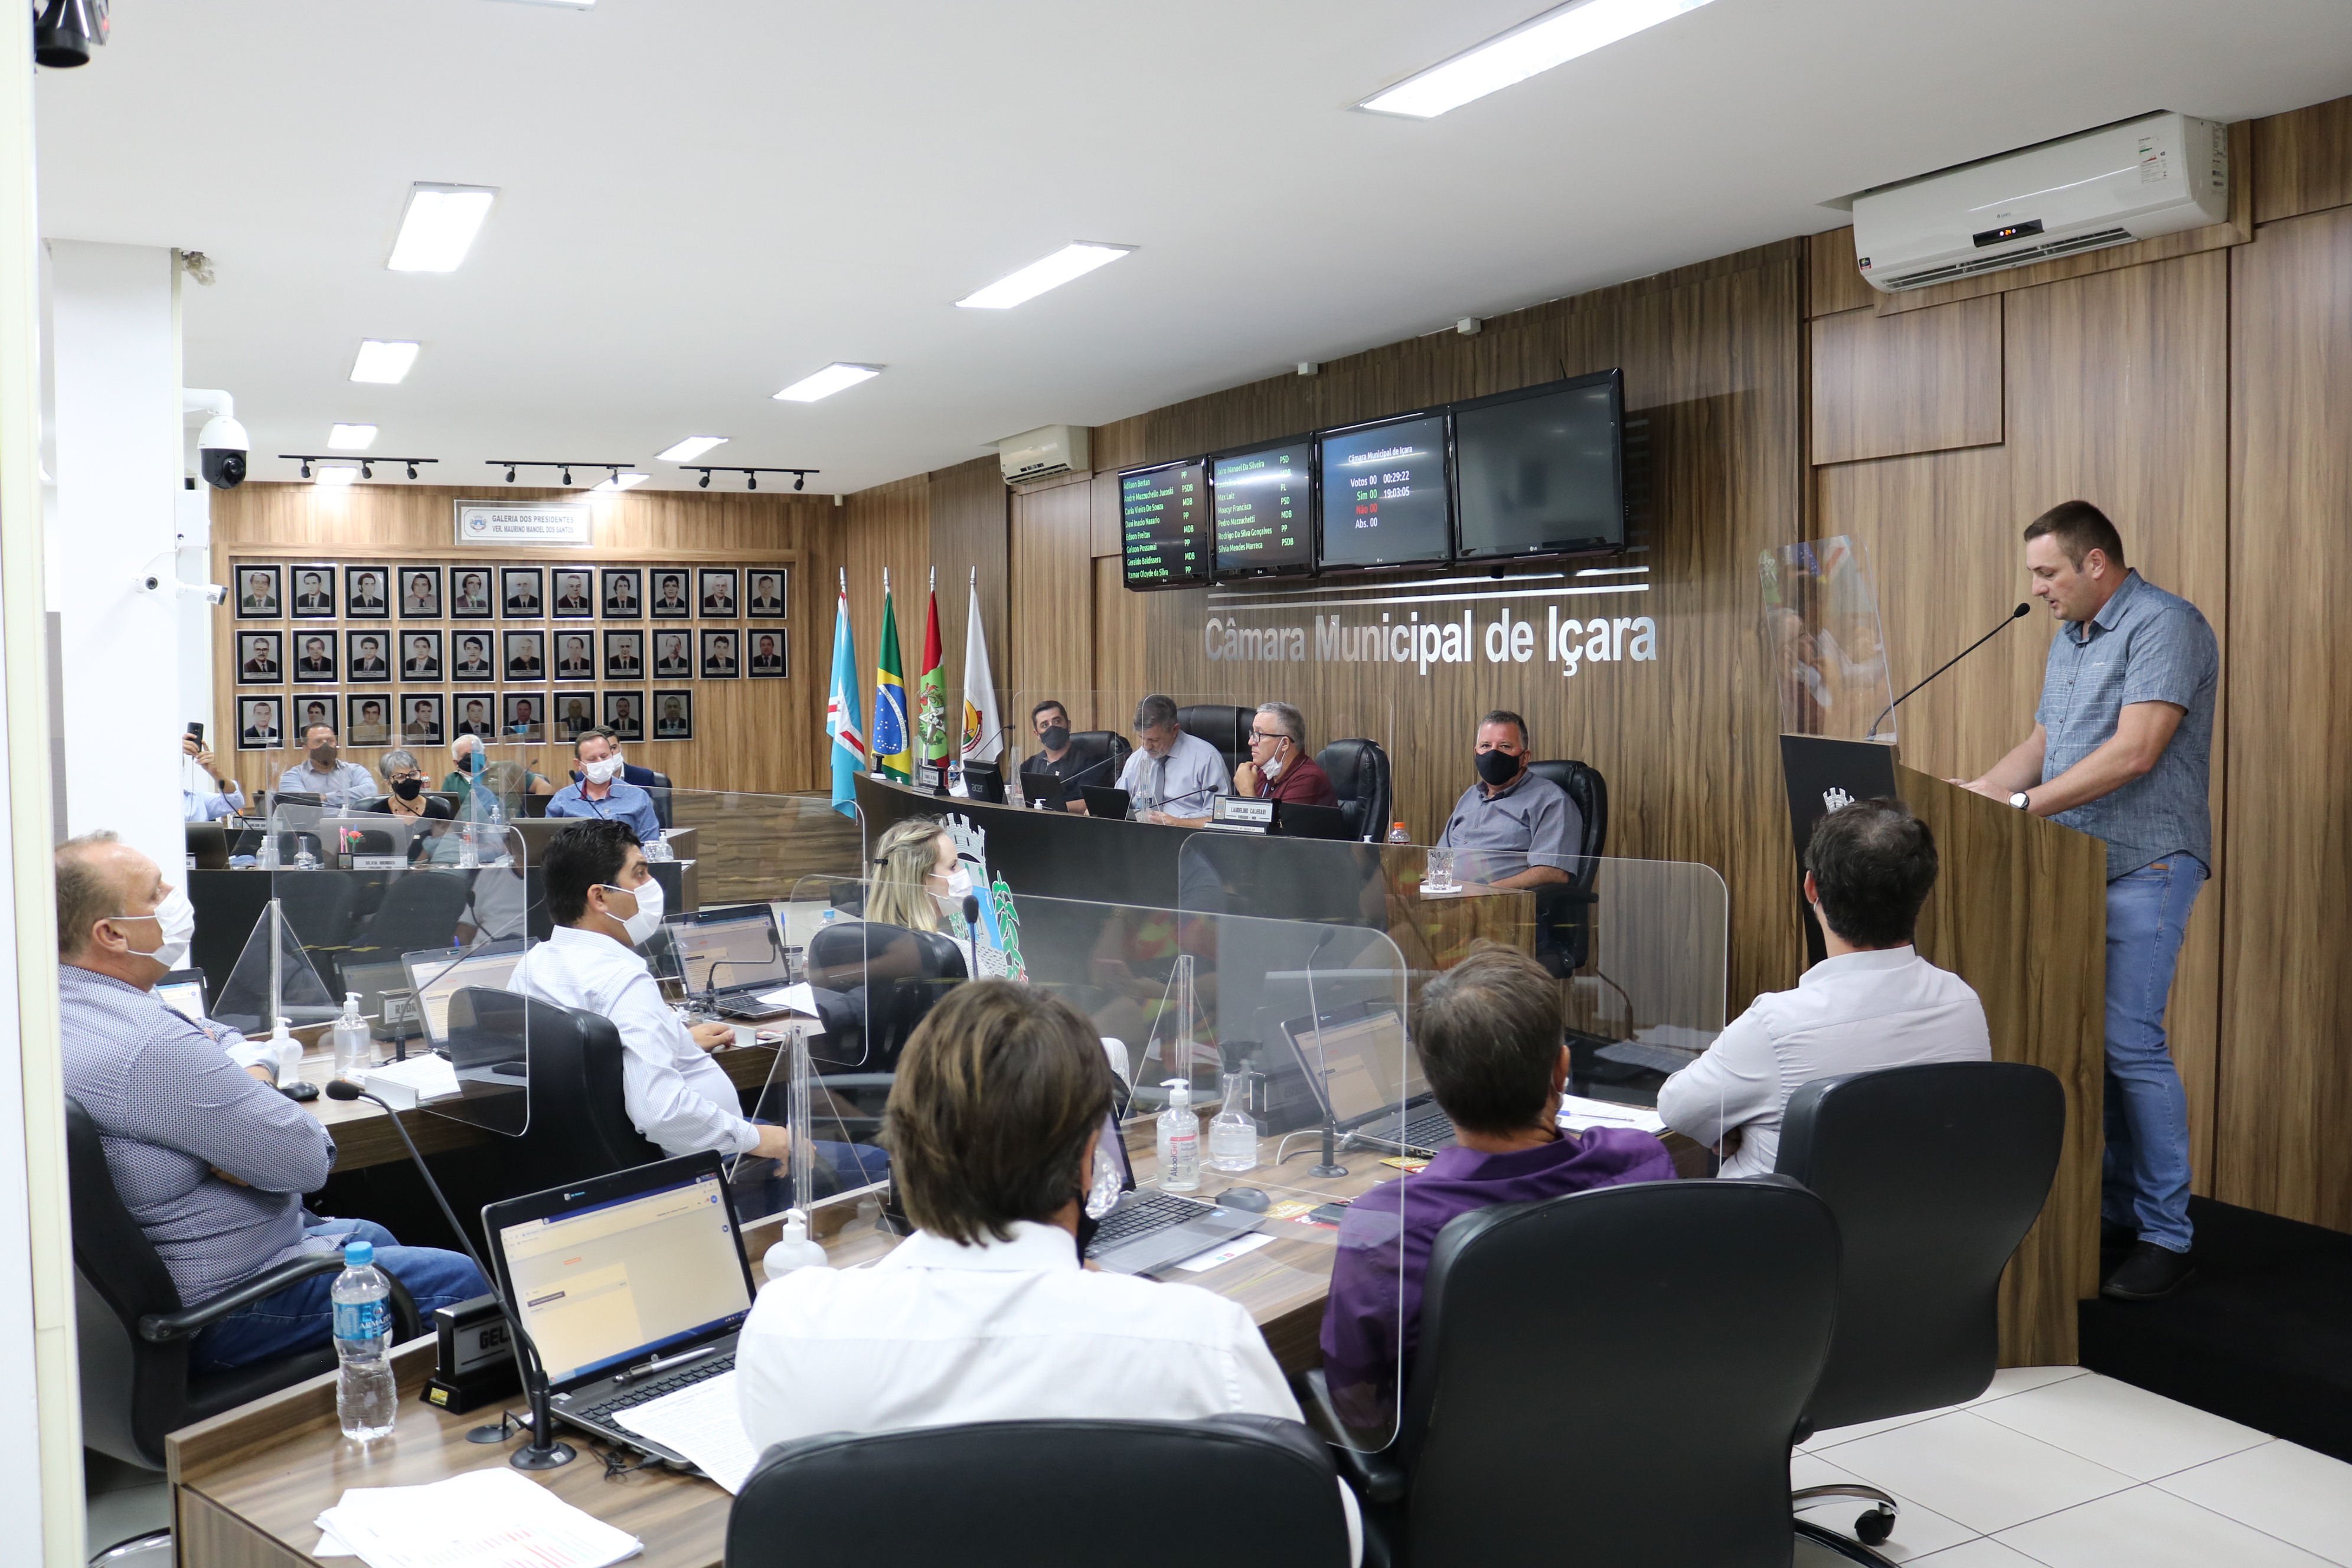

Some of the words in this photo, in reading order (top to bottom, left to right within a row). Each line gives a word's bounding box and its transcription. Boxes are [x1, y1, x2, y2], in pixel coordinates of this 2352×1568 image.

[1279, 455, 1289, 463] PSD
[1348, 454, 1367, 463] Câmara
[1367, 447, 1391, 460] Municipal
[1393, 447, 1399, 455] de
[1400, 446, 1413, 456] Içara
[1217, 468, 1227, 476] Jairo
[1227, 463, 1242, 473] Manoel
[1249, 460, 1265, 469] Silveira
[1350, 478, 1368, 488] Votos
[1369, 475, 1377, 485] 00
[1383, 471, 1410, 484] 00:29:22
[1123, 480, 1138, 489] Adilson
[1137, 479, 1151, 488] Bertan
[1182, 484, 1193, 492] PSDB
[1124, 493, 1135, 502] André
[1136, 490, 1159, 501] Mazzuchello
[1159, 486, 1174, 497] Jucoski
[1226, 492, 1235, 500] Luiz
[1357, 491, 1368, 501] Sim
[1370, 489, 1377, 498] 00
[1383, 486, 1410, 498] 19:03:05
[1182, 497, 1193, 506] MDB
[1280, 496, 1290, 505] PSD
[1125, 506, 1134, 515] Carla
[1135, 505, 1146, 514] Vieira
[1217, 505, 1232, 515] Moacyr
[1233, 503, 1252, 512] Francisco
[1355, 504, 1368, 514] Não
[1370, 503, 1378, 513] 00
[533, 515, 574, 524] PRESIDENTES
[1281, 510, 1292, 519] MDB
[1125, 520, 1133, 528] Davi
[1133, 518, 1145, 527] Inacio
[1145, 516, 1160, 525] Nazario
[1218, 519, 1230, 527] Pedro
[1230, 515, 1255, 525] Mazzuchetti
[1355, 518, 1368, 529] Abs.
[1370, 517, 1378, 527] 00
[1184, 525, 1194, 533] MDB
[1218, 530, 1234, 541] Rodrigo
[1240, 529, 1250, 537] Silva
[1251, 527, 1272, 537] Gonçalves
[1126, 533, 1137, 541] Edson
[1282, 538, 1294, 546] PSDB
[1126, 545, 1139, 553] Gelson
[1139, 543, 1157, 551] Possamai
[1219, 544, 1229, 553] Silvia
[1229, 543, 1245, 551] Mendes
[1246, 542, 1263, 550] Marreca
[1127, 557, 1142, 566] Geraldo
[1142, 556, 1161, 564] Baldissera
[1185, 552, 1195, 560] MDB
[1205, 617, 1305, 662] Câmara
[1315, 609, 1472, 676] Municipal
[1485, 607, 1534, 663] de
[1549, 606, 1657, 677] Içara
[896, 711, 907, 750] PROGRESSO
[971, 783, 984, 793] acer
